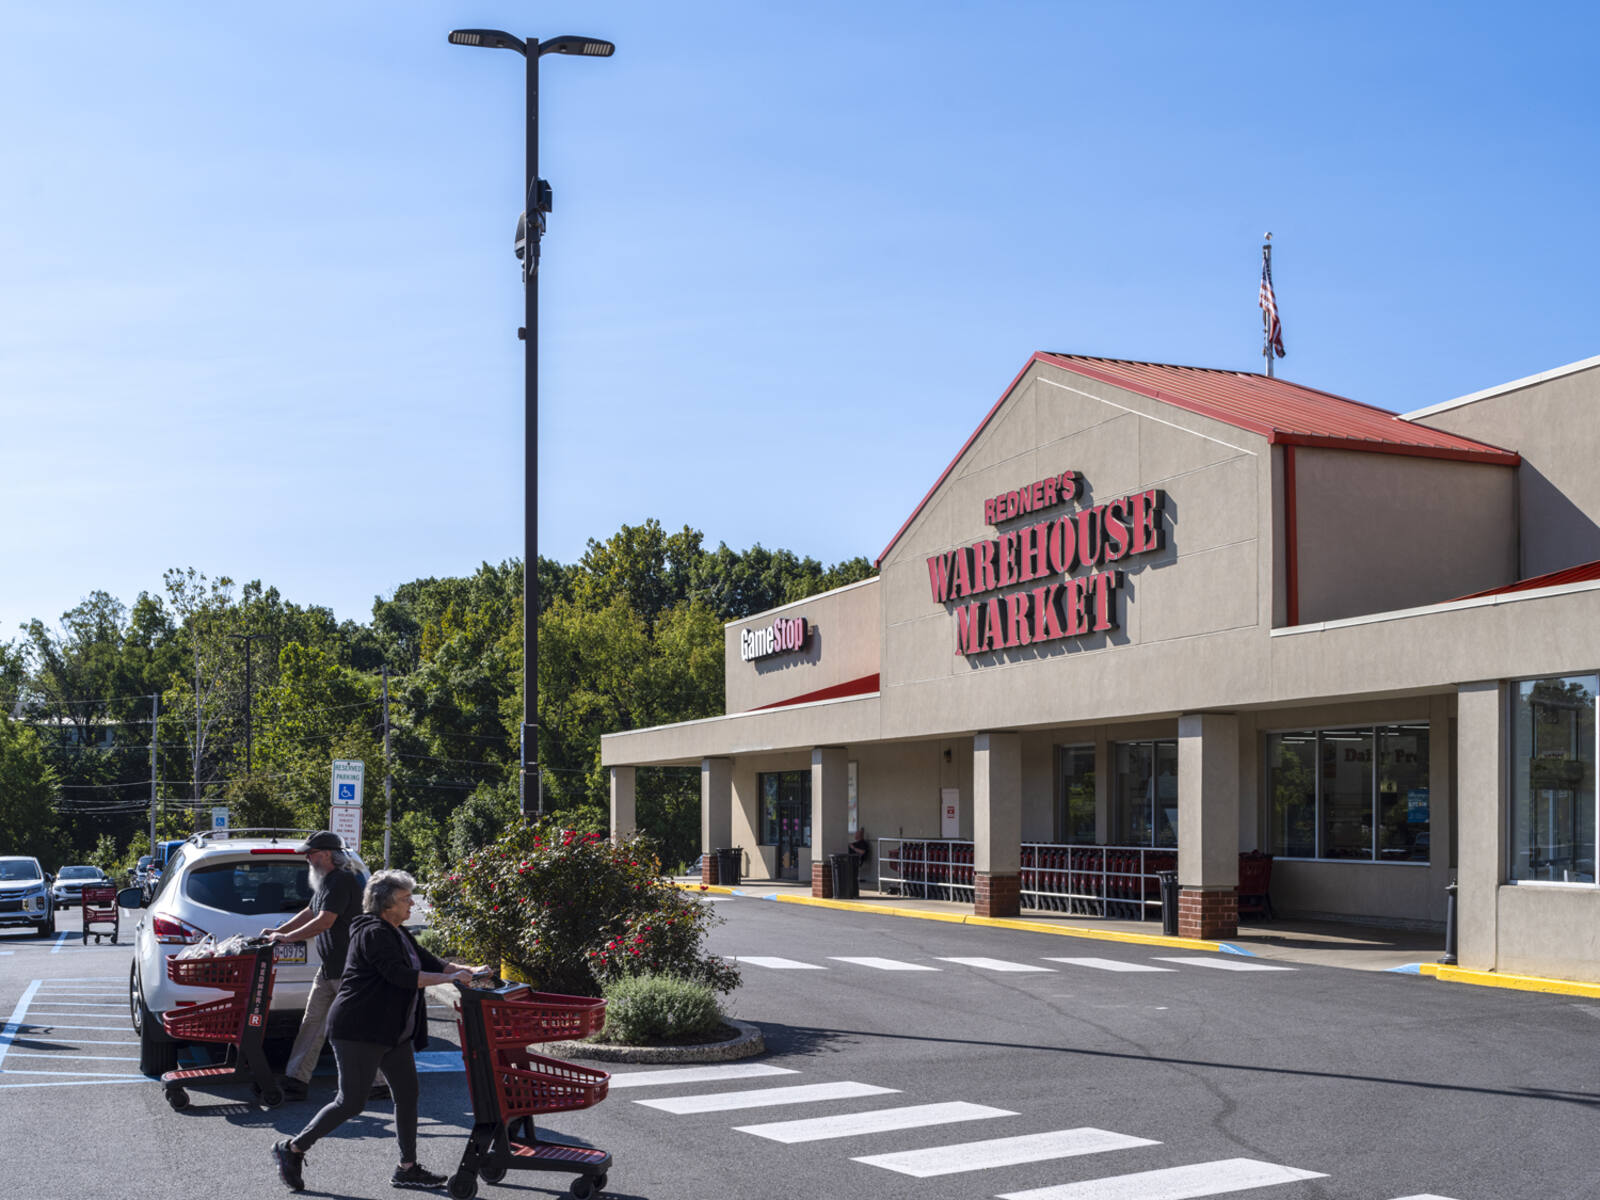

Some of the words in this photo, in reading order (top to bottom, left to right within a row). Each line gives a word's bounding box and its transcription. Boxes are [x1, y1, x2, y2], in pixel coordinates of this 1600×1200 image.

[984, 470, 1076, 526] REDNER'S
[926, 488, 1158, 604] WAREHOUSE
[954, 570, 1117, 656] MARKET
[740, 616, 805, 662] GameStop
[335, 764, 362, 772] RESERVED
[336, 773, 360, 781] PARKING
